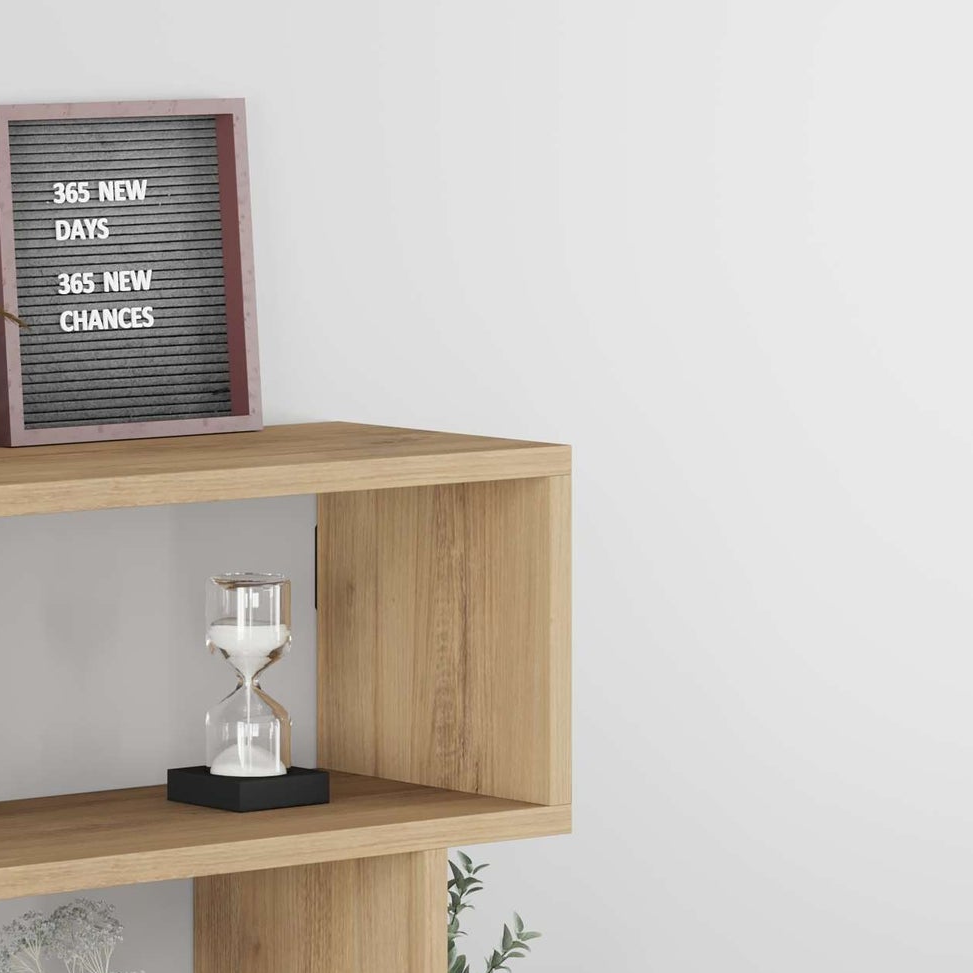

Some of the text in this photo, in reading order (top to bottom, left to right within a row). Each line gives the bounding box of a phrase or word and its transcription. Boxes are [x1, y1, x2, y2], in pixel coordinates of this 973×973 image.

[53, 179, 147, 204] 365 NEW
[55, 218, 110, 241] DAYS
[58, 269, 152, 295] 365 NEW
[59, 306, 155, 332] CHANCES
